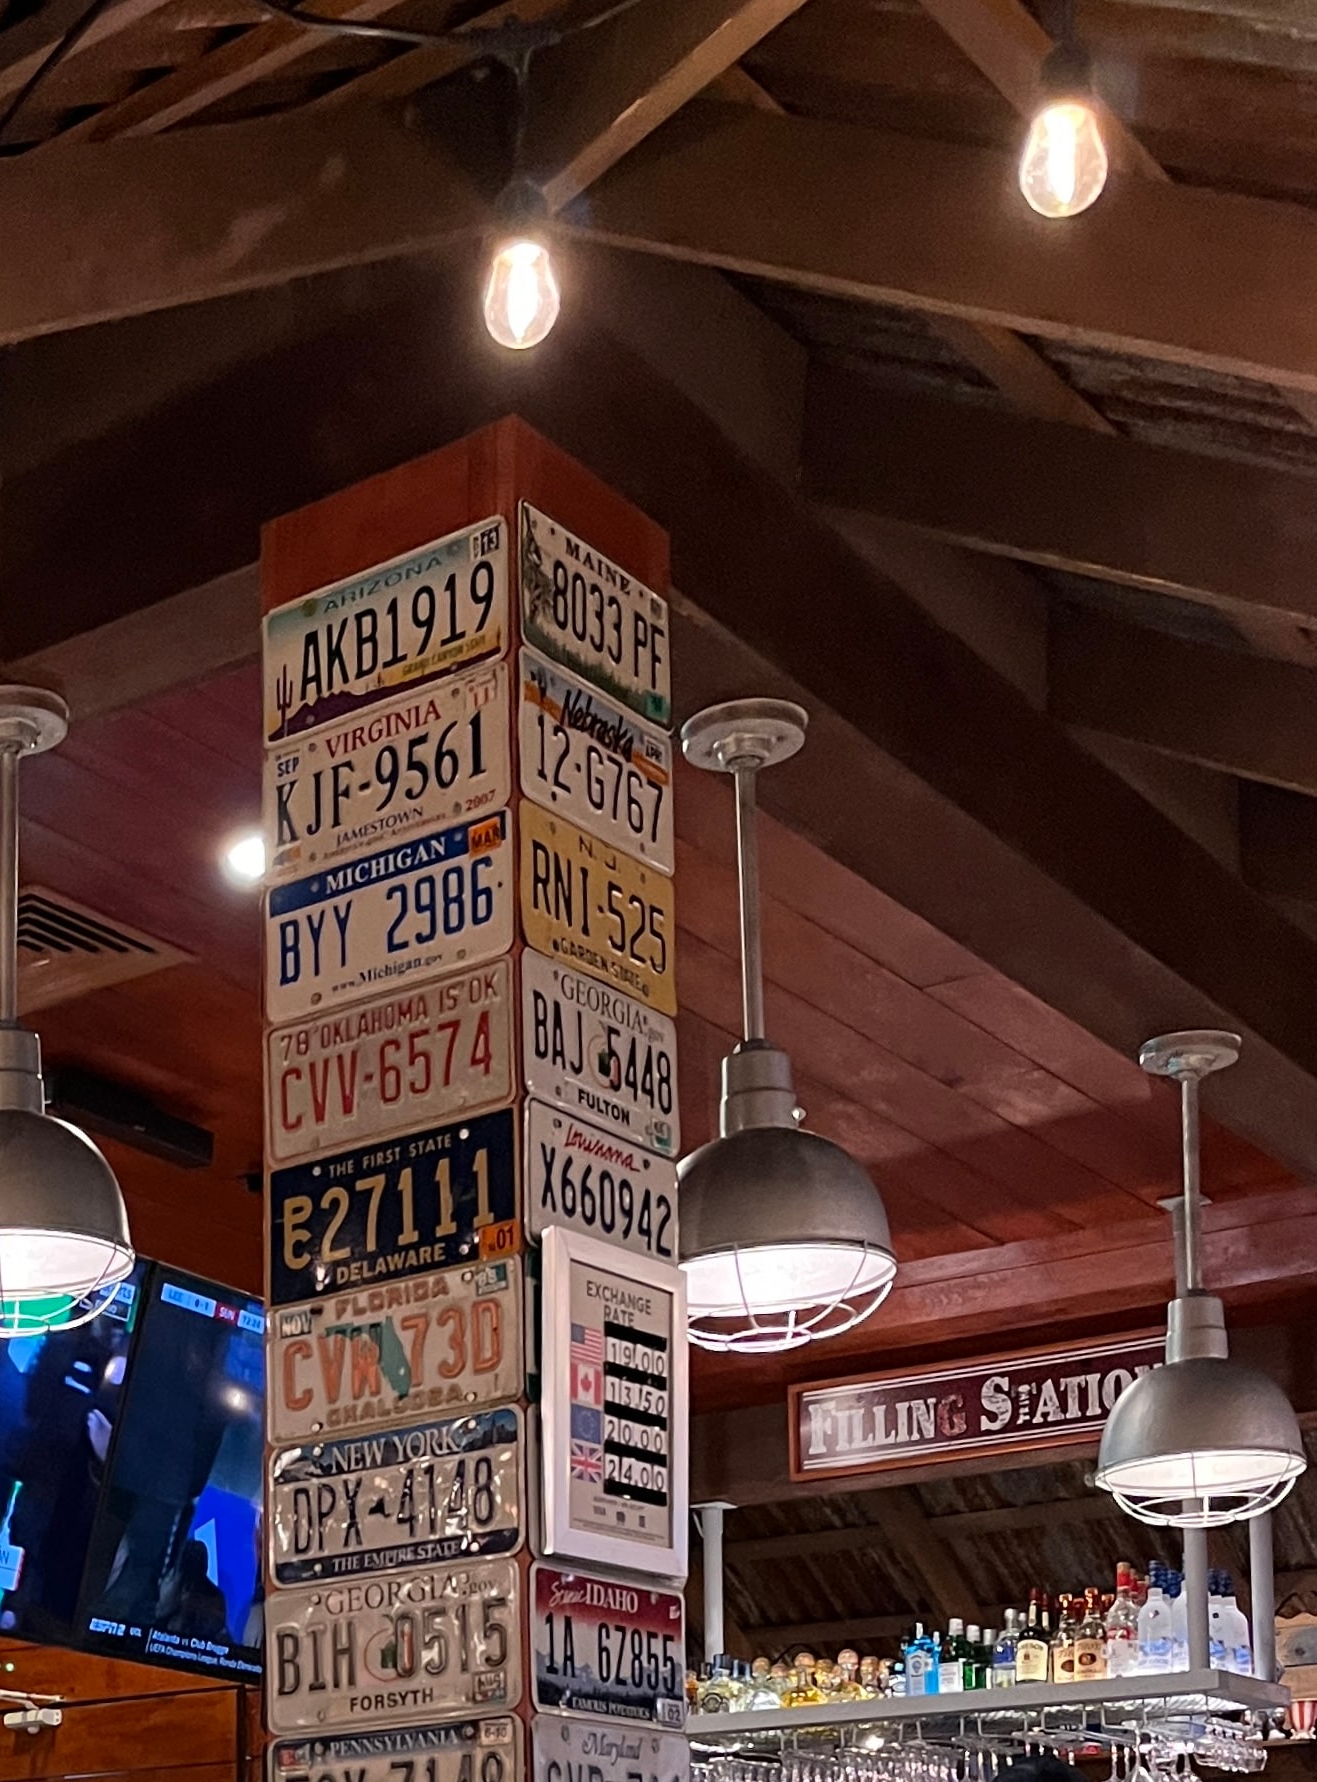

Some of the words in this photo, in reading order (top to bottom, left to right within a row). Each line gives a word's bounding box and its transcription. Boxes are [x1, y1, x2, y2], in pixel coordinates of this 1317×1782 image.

[323, 557, 442, 614] ARIZONA
[565, 536, 631, 596] MAINE
[300, 561, 495, 701] AKB1919
[553, 559, 622, 665] 8033
[634, 610, 665, 690] PF
[326, 699, 441, 758] VIRGINIA
[560, 689, 634, 763] Nebraska
[276, 710, 487, 848] KJF-9561
[277, 756, 300, 778] SEP
[337, 806, 424, 847] JAMESTOWN
[326, 837, 446, 894] MICHIGAN
[280, 899, 353, 986] BYY
[386, 855, 493, 954] 2986
[320, 994, 427, 1050] OKLAHOMA
[439, 979, 458, 1014] IS
[469, 972, 498, 1005] OK
[281, 1010, 491, 1131] CVV-6574
[533, 989, 583, 1076] BAJ
[607, 1025, 672, 1115] 5448
[578, 1087, 630, 1127] FULTON
[328, 1158, 354, 1179] THE
[363, 1146, 400, 1171] FIRST
[409, 1133, 451, 1159] STATE
[564, 1122, 641, 1174] Louisiana
[540, 1142, 672, 1258] X660942
[337, 1243, 446, 1286] DELAWARE
[335, 1275, 450, 1320] FLORIDA
[586, 1280, 652, 1316] EXCHANGE
[604, 1305, 634, 1328] RATE
[611, 1342, 665, 1377] 19.00
[807, 1394, 967, 1455] FILLING
[980, 1362, 1165, 1432] STATIO
[333, 1437, 386, 1473] NEW
[393, 1424, 464, 1462] YORK
[607, 1419, 664, 1454] 20.00
[608, 1459, 665, 1490] 24.00
[333, 1556, 360, 1574] THE
[416, 1540, 460, 1561] STATE
[585, 1583, 639, 1614] IDAHO
[545, 1612, 576, 1679] 1A
[350, 1687, 434, 1713] FORSYTH
[330, 1727, 458, 1757] PENNSYLVANIA
[583, 1732, 642, 1766] Maryland
